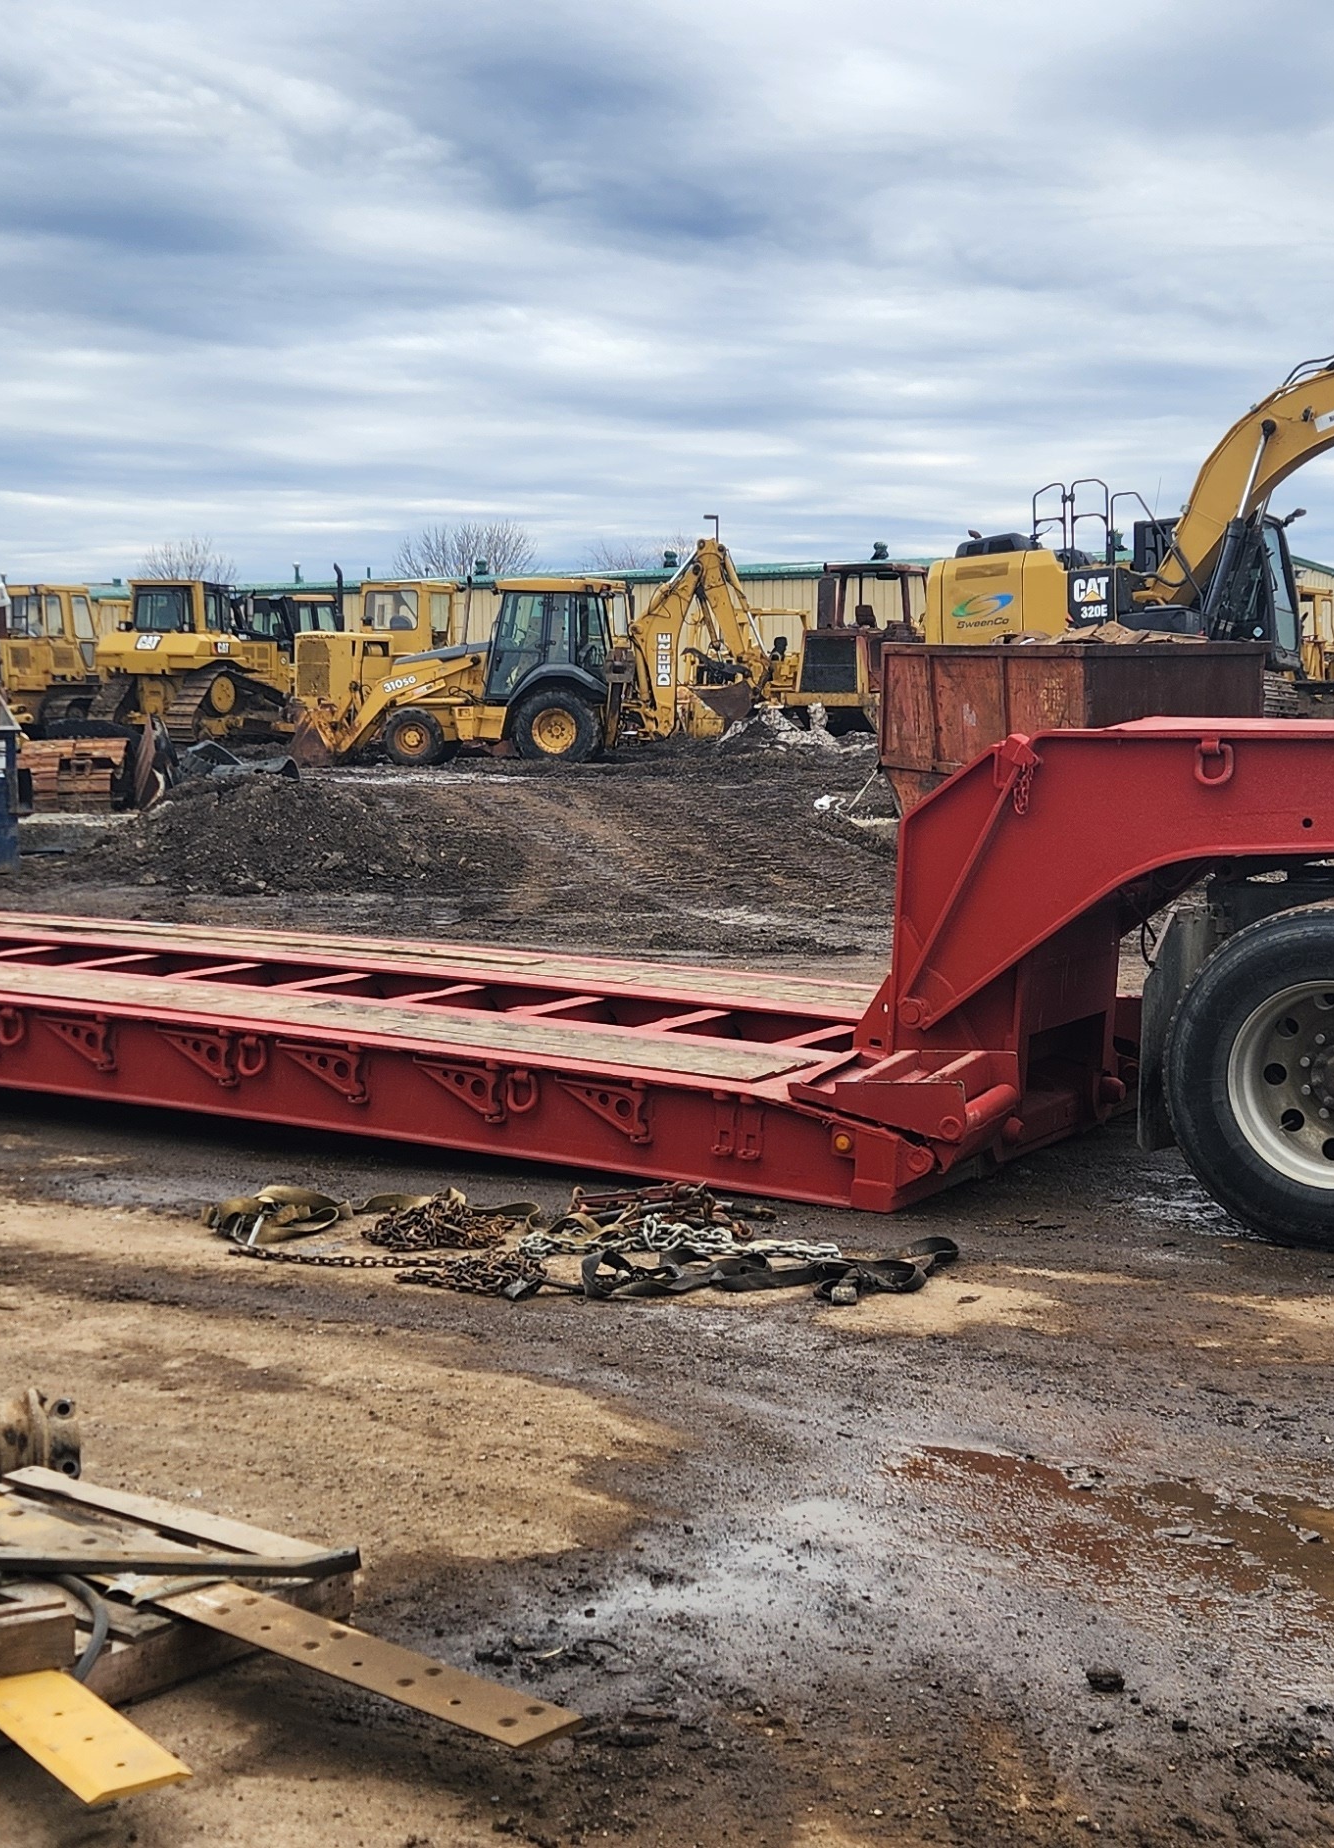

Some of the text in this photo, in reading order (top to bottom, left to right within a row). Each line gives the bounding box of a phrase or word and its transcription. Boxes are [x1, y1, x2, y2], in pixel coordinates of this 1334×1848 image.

[1073, 577, 1109, 603] CAT
[1080, 604, 1108, 619] 320E
[956, 617, 1010, 629] SweenCo
[136, 635, 161, 650] CAT
[217, 642, 230, 653] CAT
[657, 633, 671, 686] DEERE
